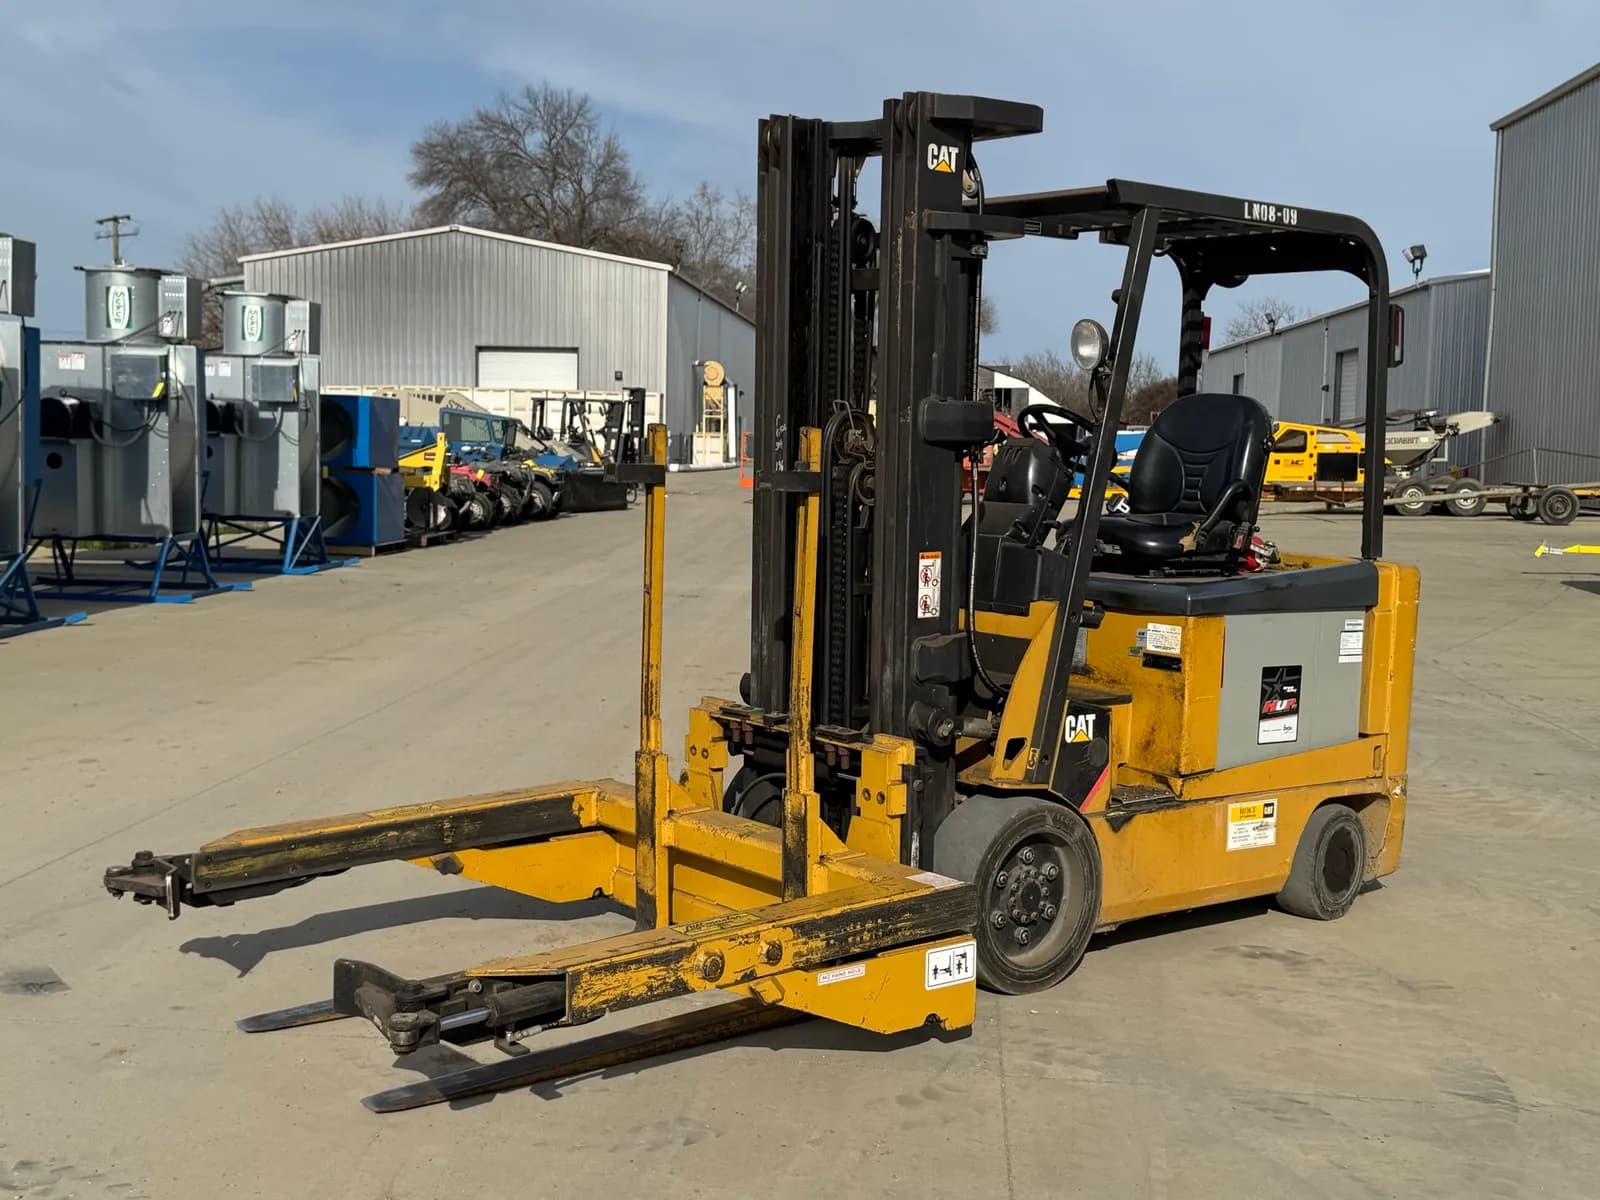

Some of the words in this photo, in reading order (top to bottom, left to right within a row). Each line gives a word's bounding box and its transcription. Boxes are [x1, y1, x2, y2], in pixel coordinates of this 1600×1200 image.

[927, 143, 959, 173] CAT
[1244, 202, 1298, 226] LN08-09
[1065, 714, 1096, 743] CAT
